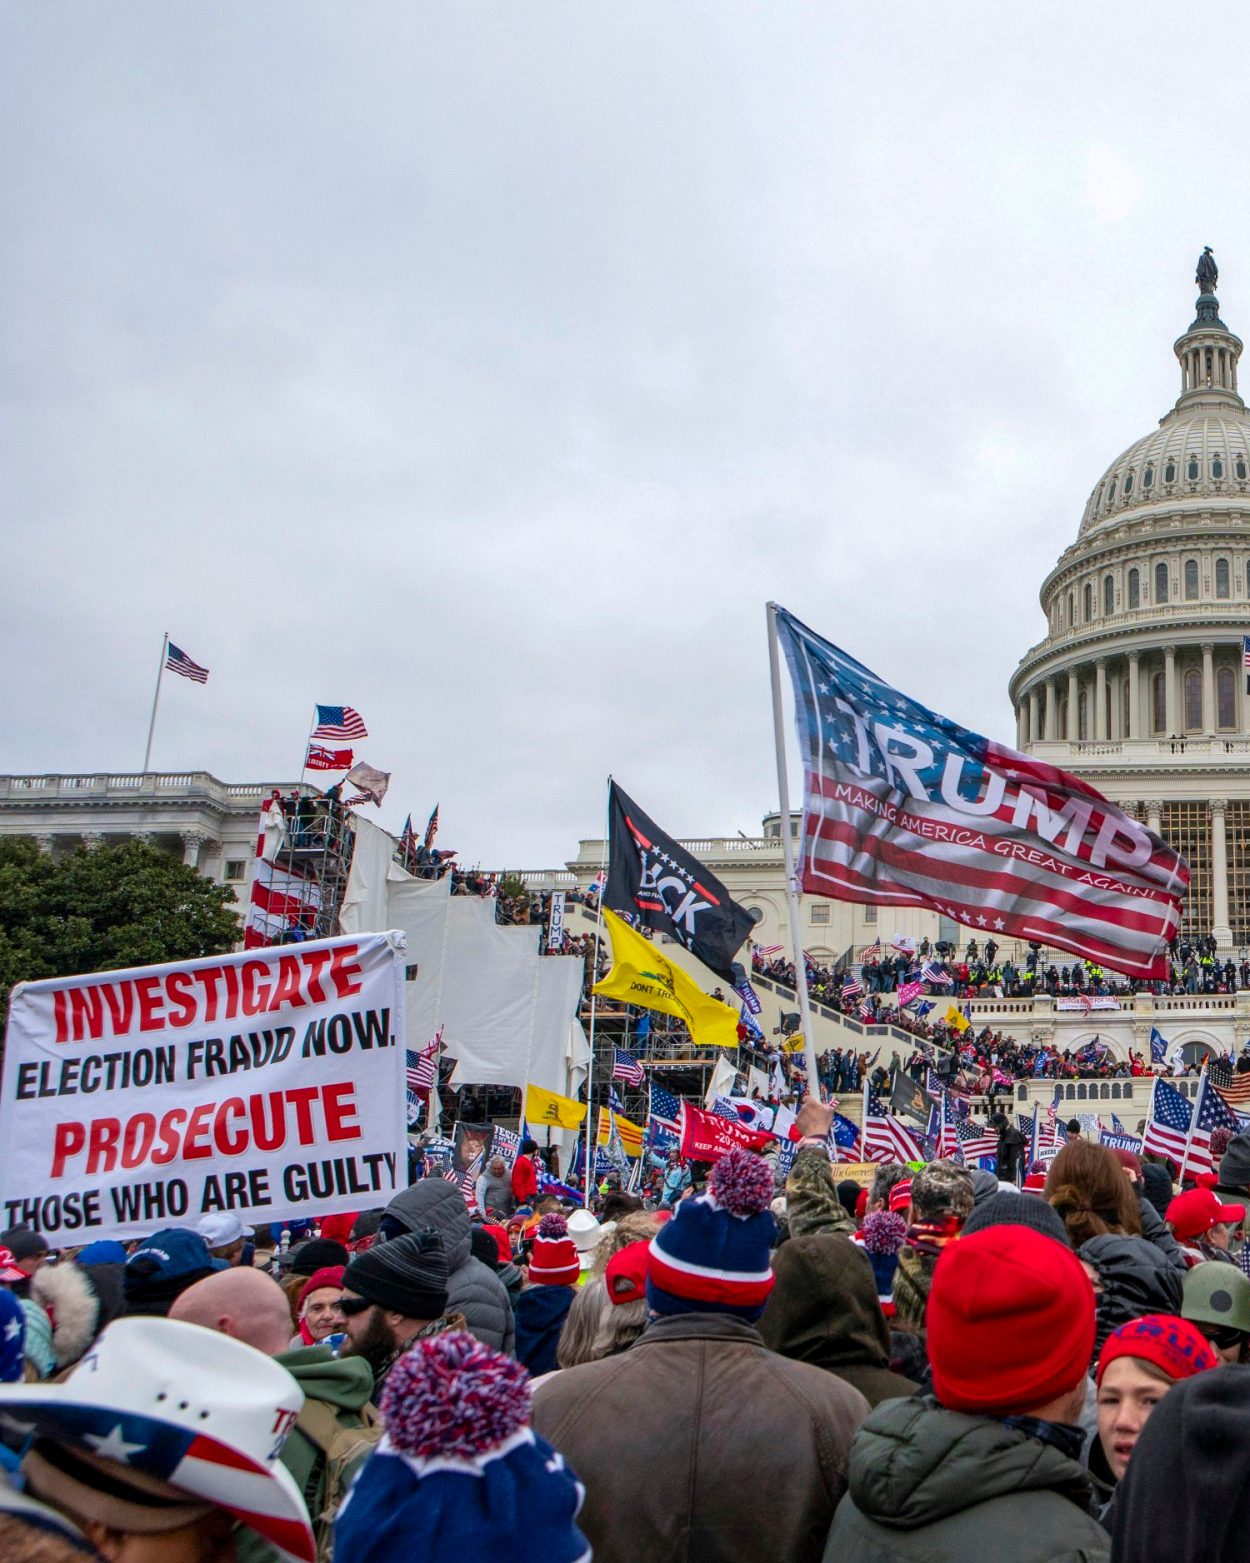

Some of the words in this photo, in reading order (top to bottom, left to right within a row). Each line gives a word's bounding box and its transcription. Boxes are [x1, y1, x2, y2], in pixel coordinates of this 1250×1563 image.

[835, 698, 1154, 869] TRUMP
[835, 784, 897, 823] MAKING
[901, 813, 986, 852] AMERICA
[994, 841, 1073, 876] GREAT
[1077, 871, 1155, 900] AGAIN!
[551, 894, 562, 947] TRUMP
[52, 943, 363, 1044] INVESTIGATE
[741, 981, 761, 1013] TRUMP
[15, 1044, 175, 1100] ELECTION
[187, 1025, 296, 1080] FRAUD
[301, 1007, 396, 1059] NOW.
[50, 1081, 363, 1178] PROSECUTE
[695, 1142, 712, 1150] KEEP
[1103, 1136, 1142, 1153] TRUMP
[2, 1188, 103, 1232] THOSE
[110, 1177, 189, 1224] WHO
[200, 1168, 273, 1214] ARE
[282, 1151, 397, 1203] GUILTY
